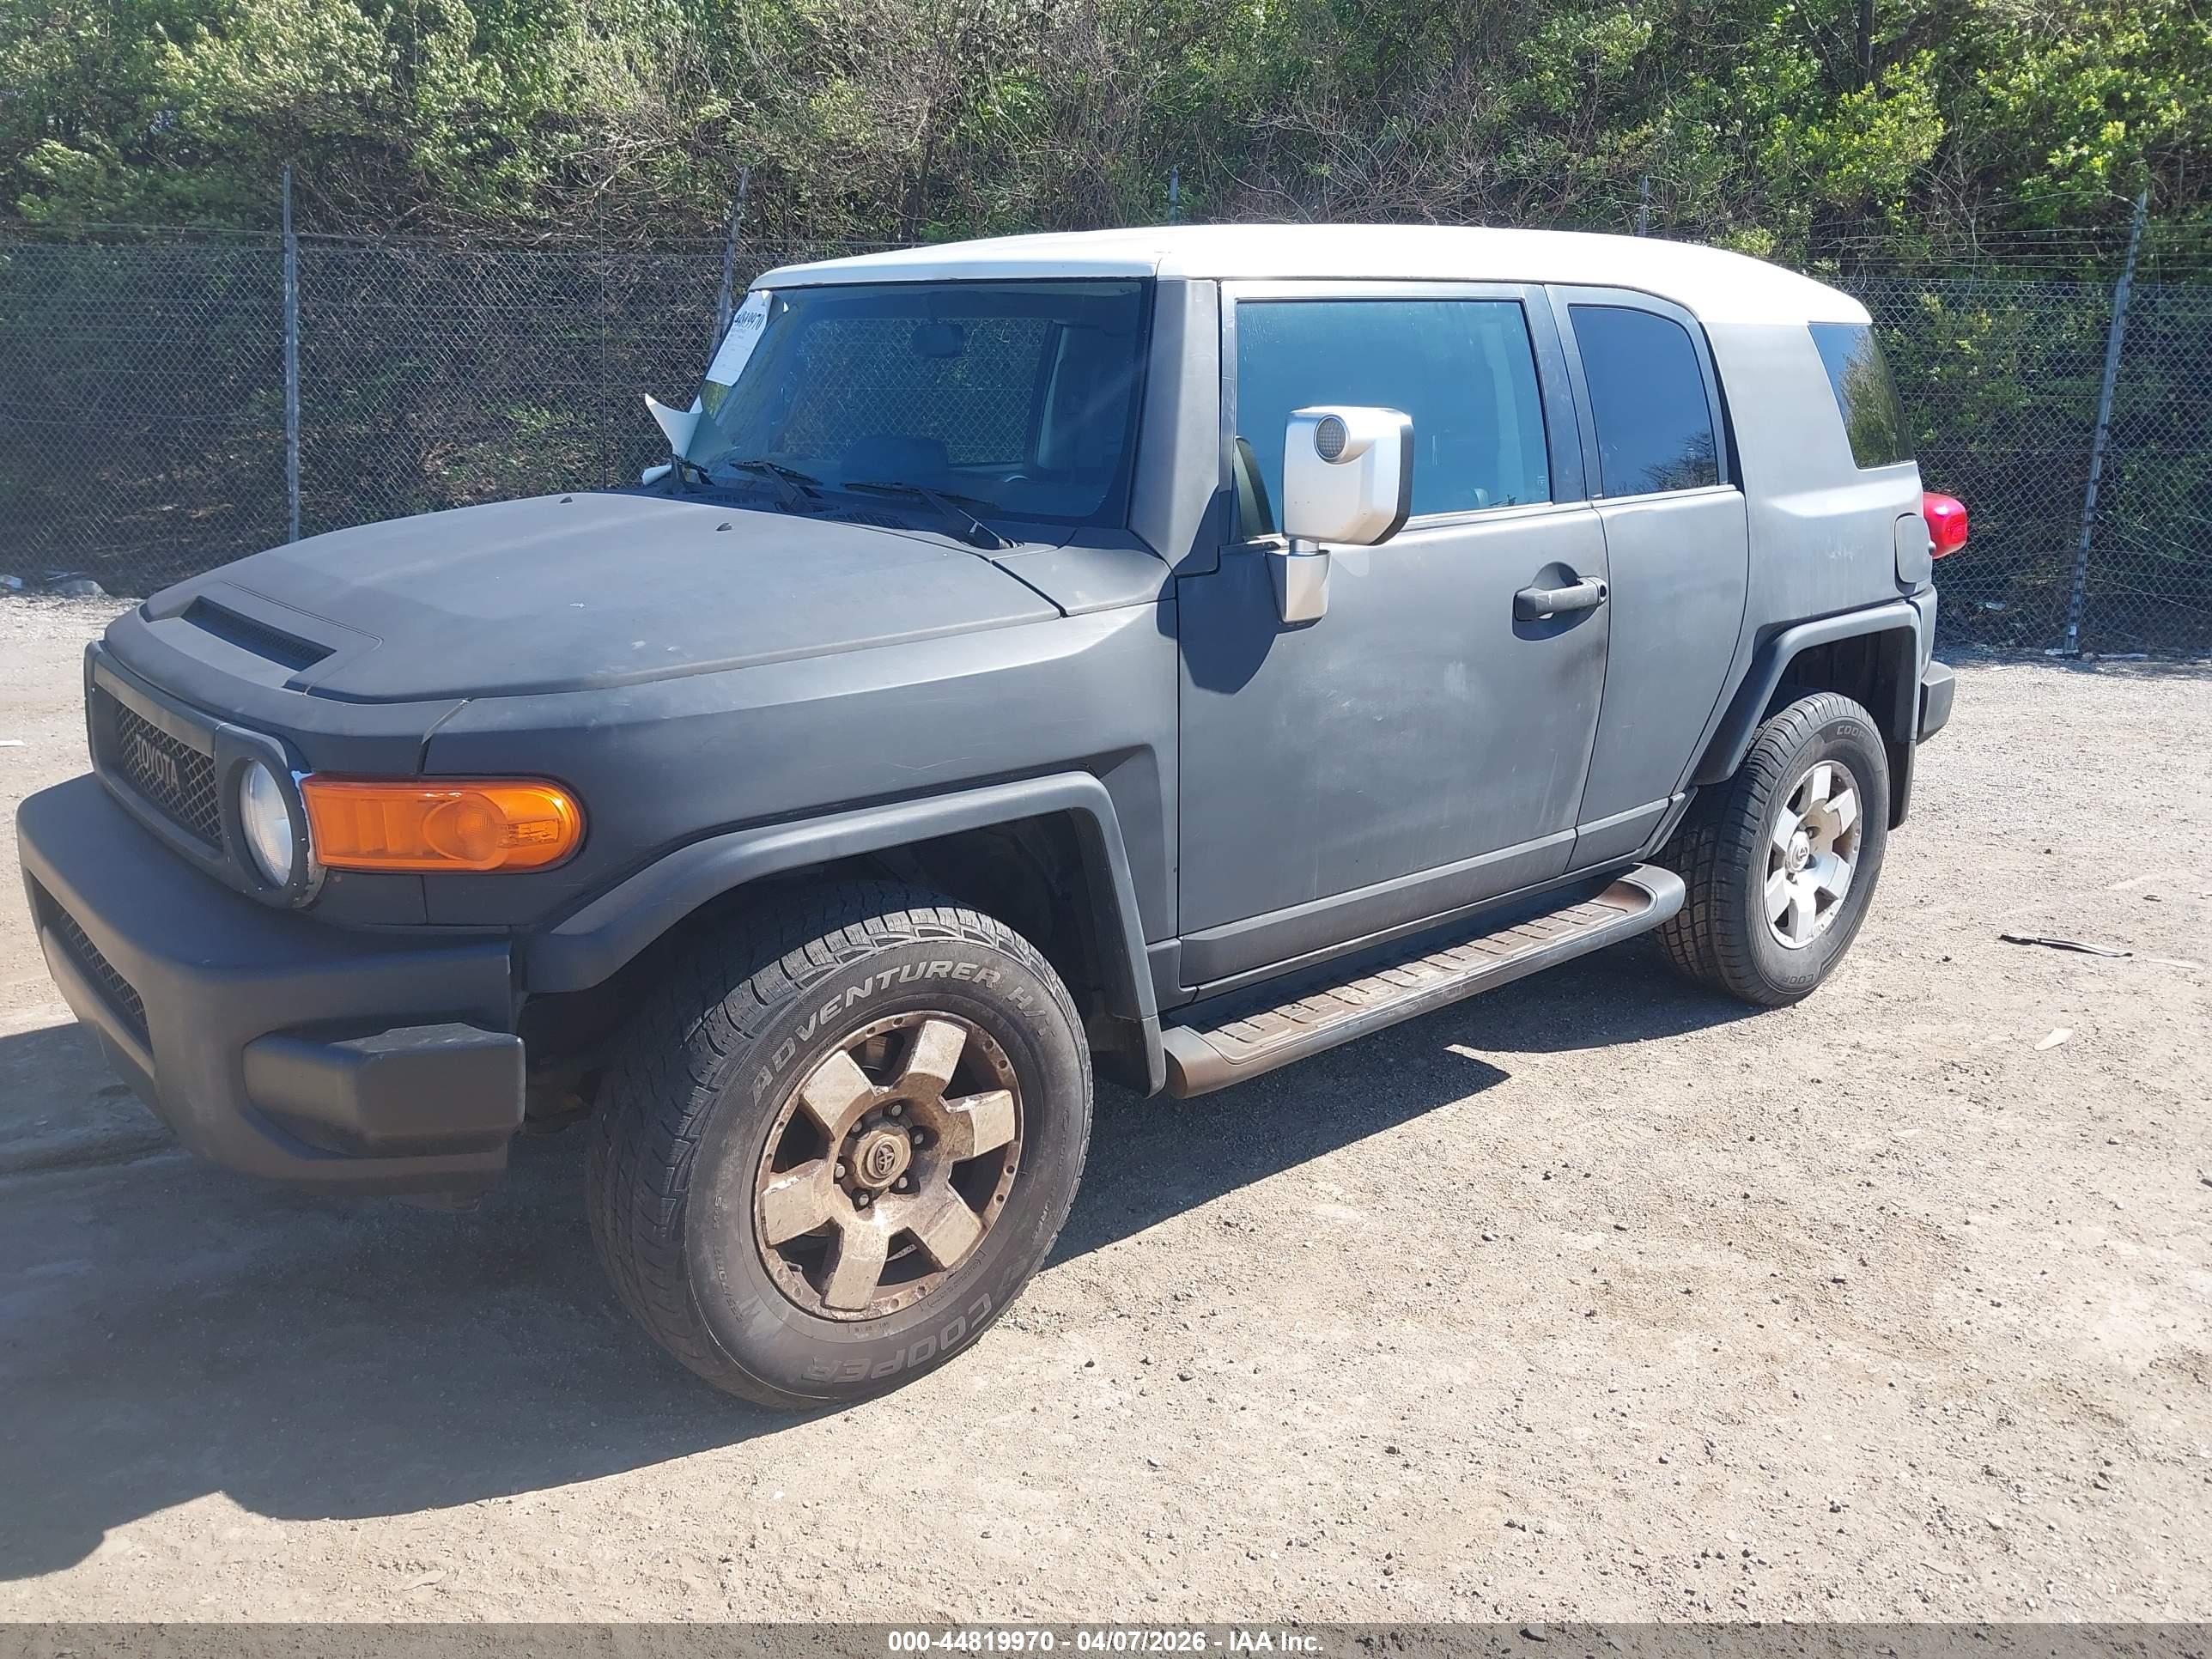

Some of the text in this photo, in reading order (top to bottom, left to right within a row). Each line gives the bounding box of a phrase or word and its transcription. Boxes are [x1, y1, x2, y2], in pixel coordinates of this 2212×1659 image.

[137, 733, 181, 793] TOYOTA
[751, 960, 1001, 1107] ADVENTURER
[1006, 987, 1057, 1038] H/T
[800, 1292, 994, 1383] COOPER
